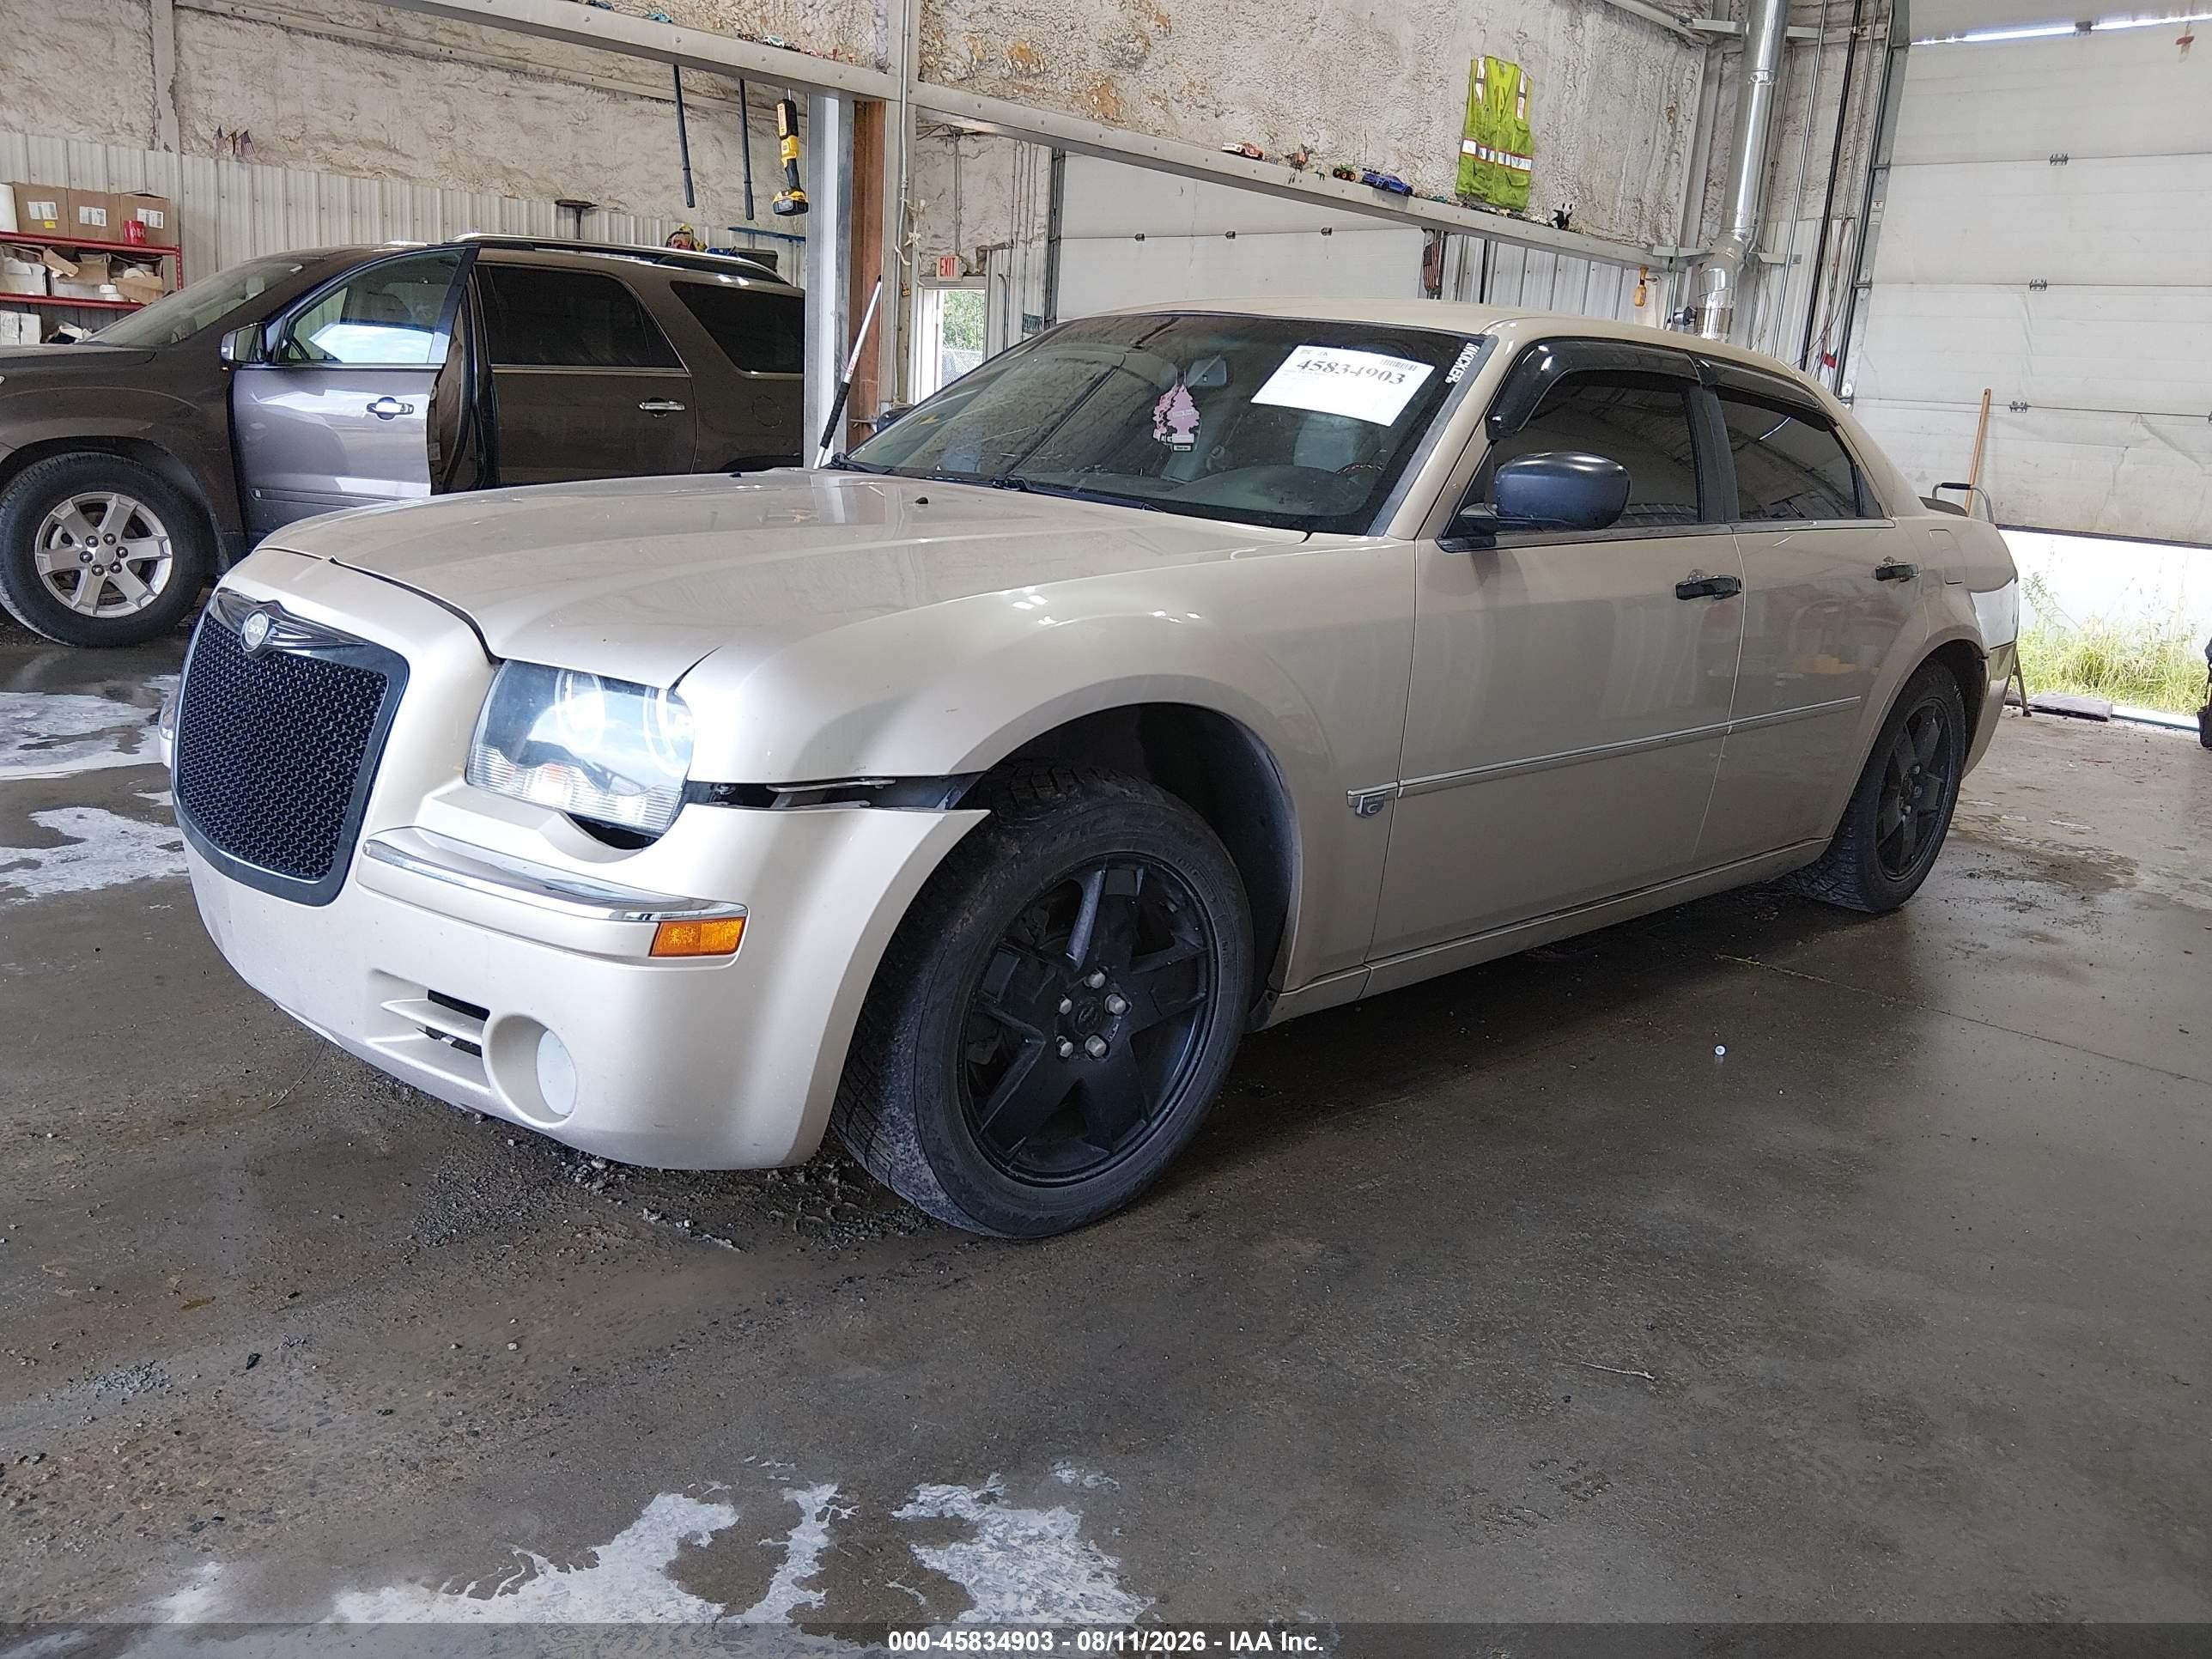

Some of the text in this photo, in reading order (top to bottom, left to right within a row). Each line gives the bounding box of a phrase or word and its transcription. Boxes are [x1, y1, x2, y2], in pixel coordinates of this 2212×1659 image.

[940, 257, 955, 276] EXIT
[1297, 359, 1406, 385] 45834903
[1447, 345, 1479, 383] KICKER
[247, 623, 264, 636] 300
